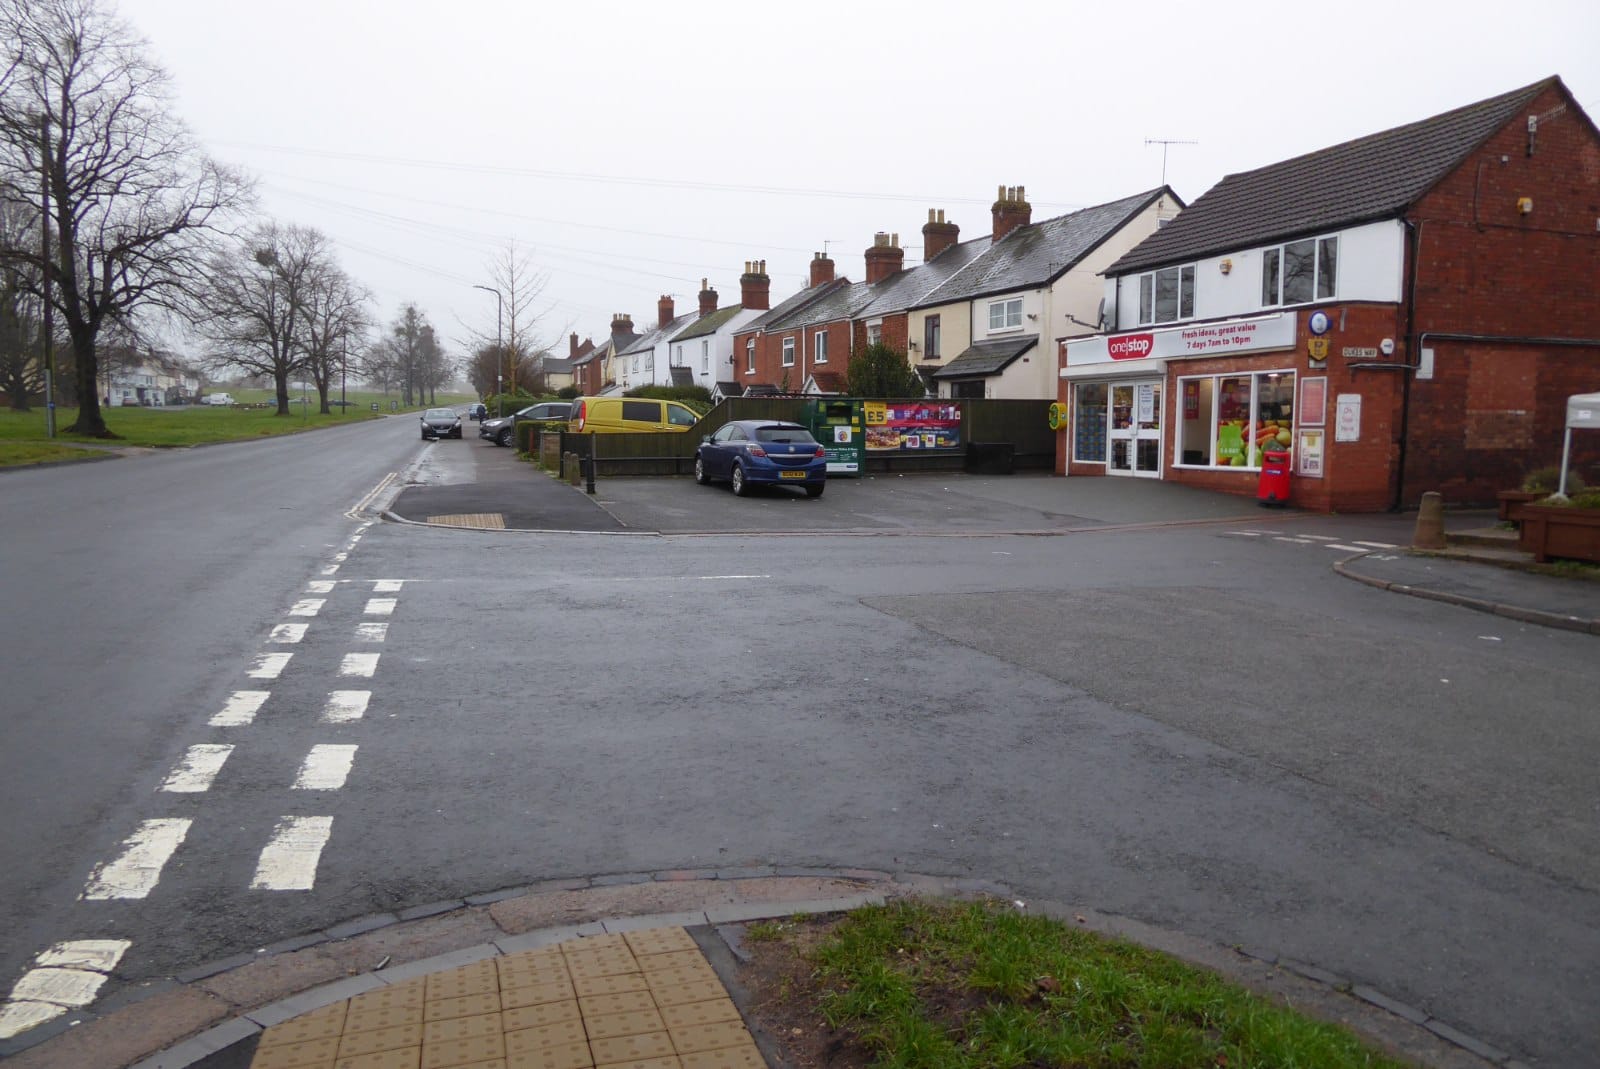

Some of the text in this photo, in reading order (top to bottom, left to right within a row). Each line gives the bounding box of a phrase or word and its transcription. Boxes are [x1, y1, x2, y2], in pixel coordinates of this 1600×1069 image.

[1182, 329, 1198, 339] fresh
[1218, 325, 1236, 337] great
[1237, 322, 1257, 332] value
[1186, 341, 1191, 349] 7
[1192, 340, 1207, 350] days
[1208, 339, 1222, 347] 7am
[1232, 336, 1251, 346] 10pm
[867, 411, 884, 422] £5
